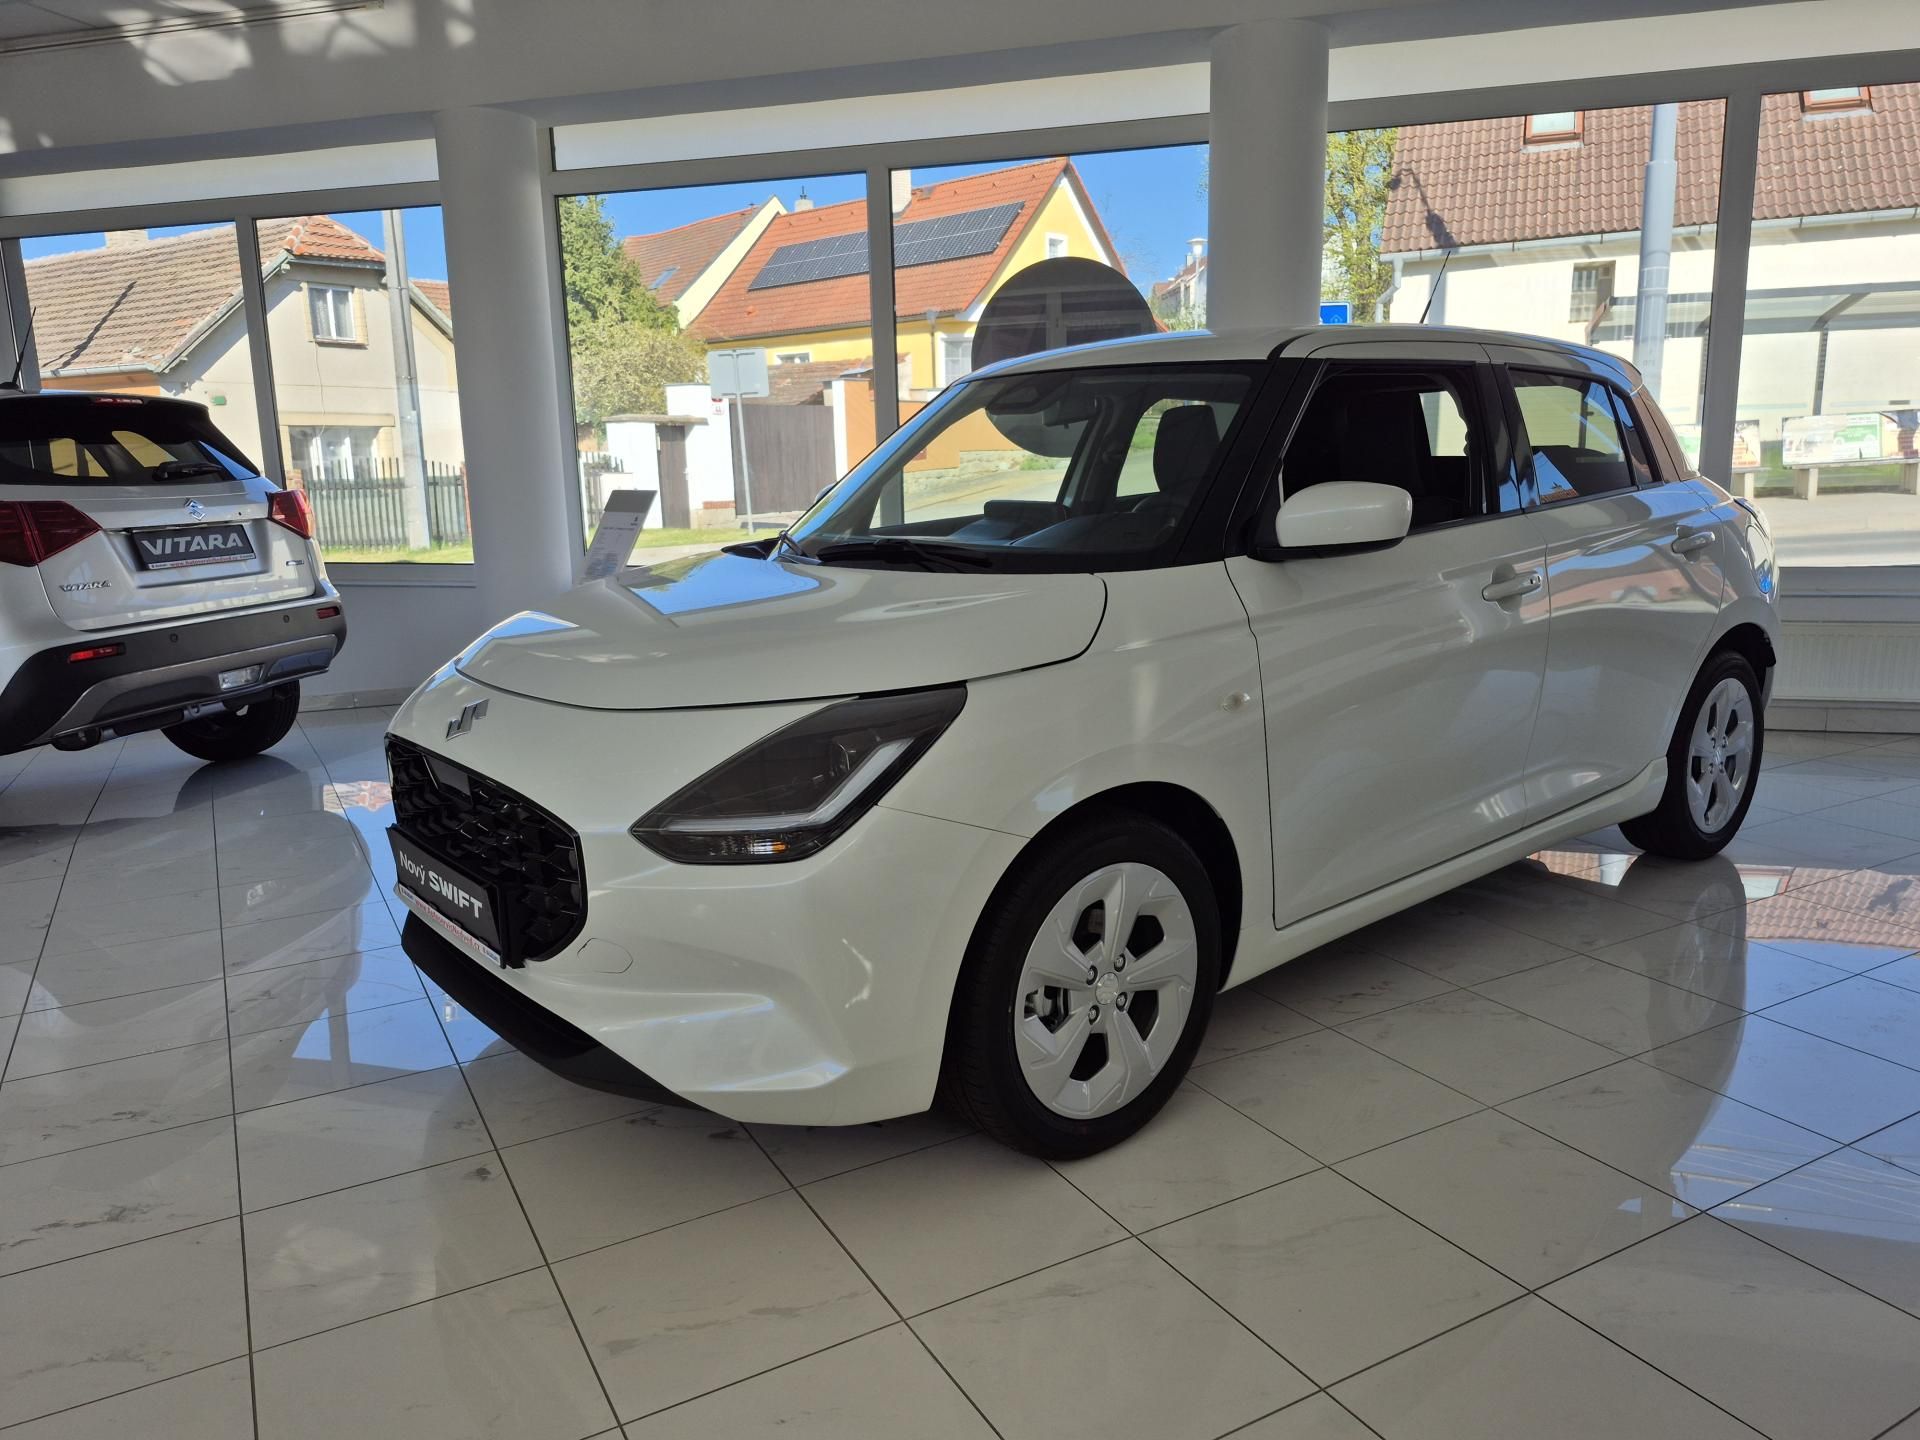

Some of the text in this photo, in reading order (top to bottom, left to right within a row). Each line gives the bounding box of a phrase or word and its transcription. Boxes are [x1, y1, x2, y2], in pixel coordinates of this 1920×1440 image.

[141, 533, 243, 555] VITARA
[399, 850, 483, 919] Nový SWIFT
